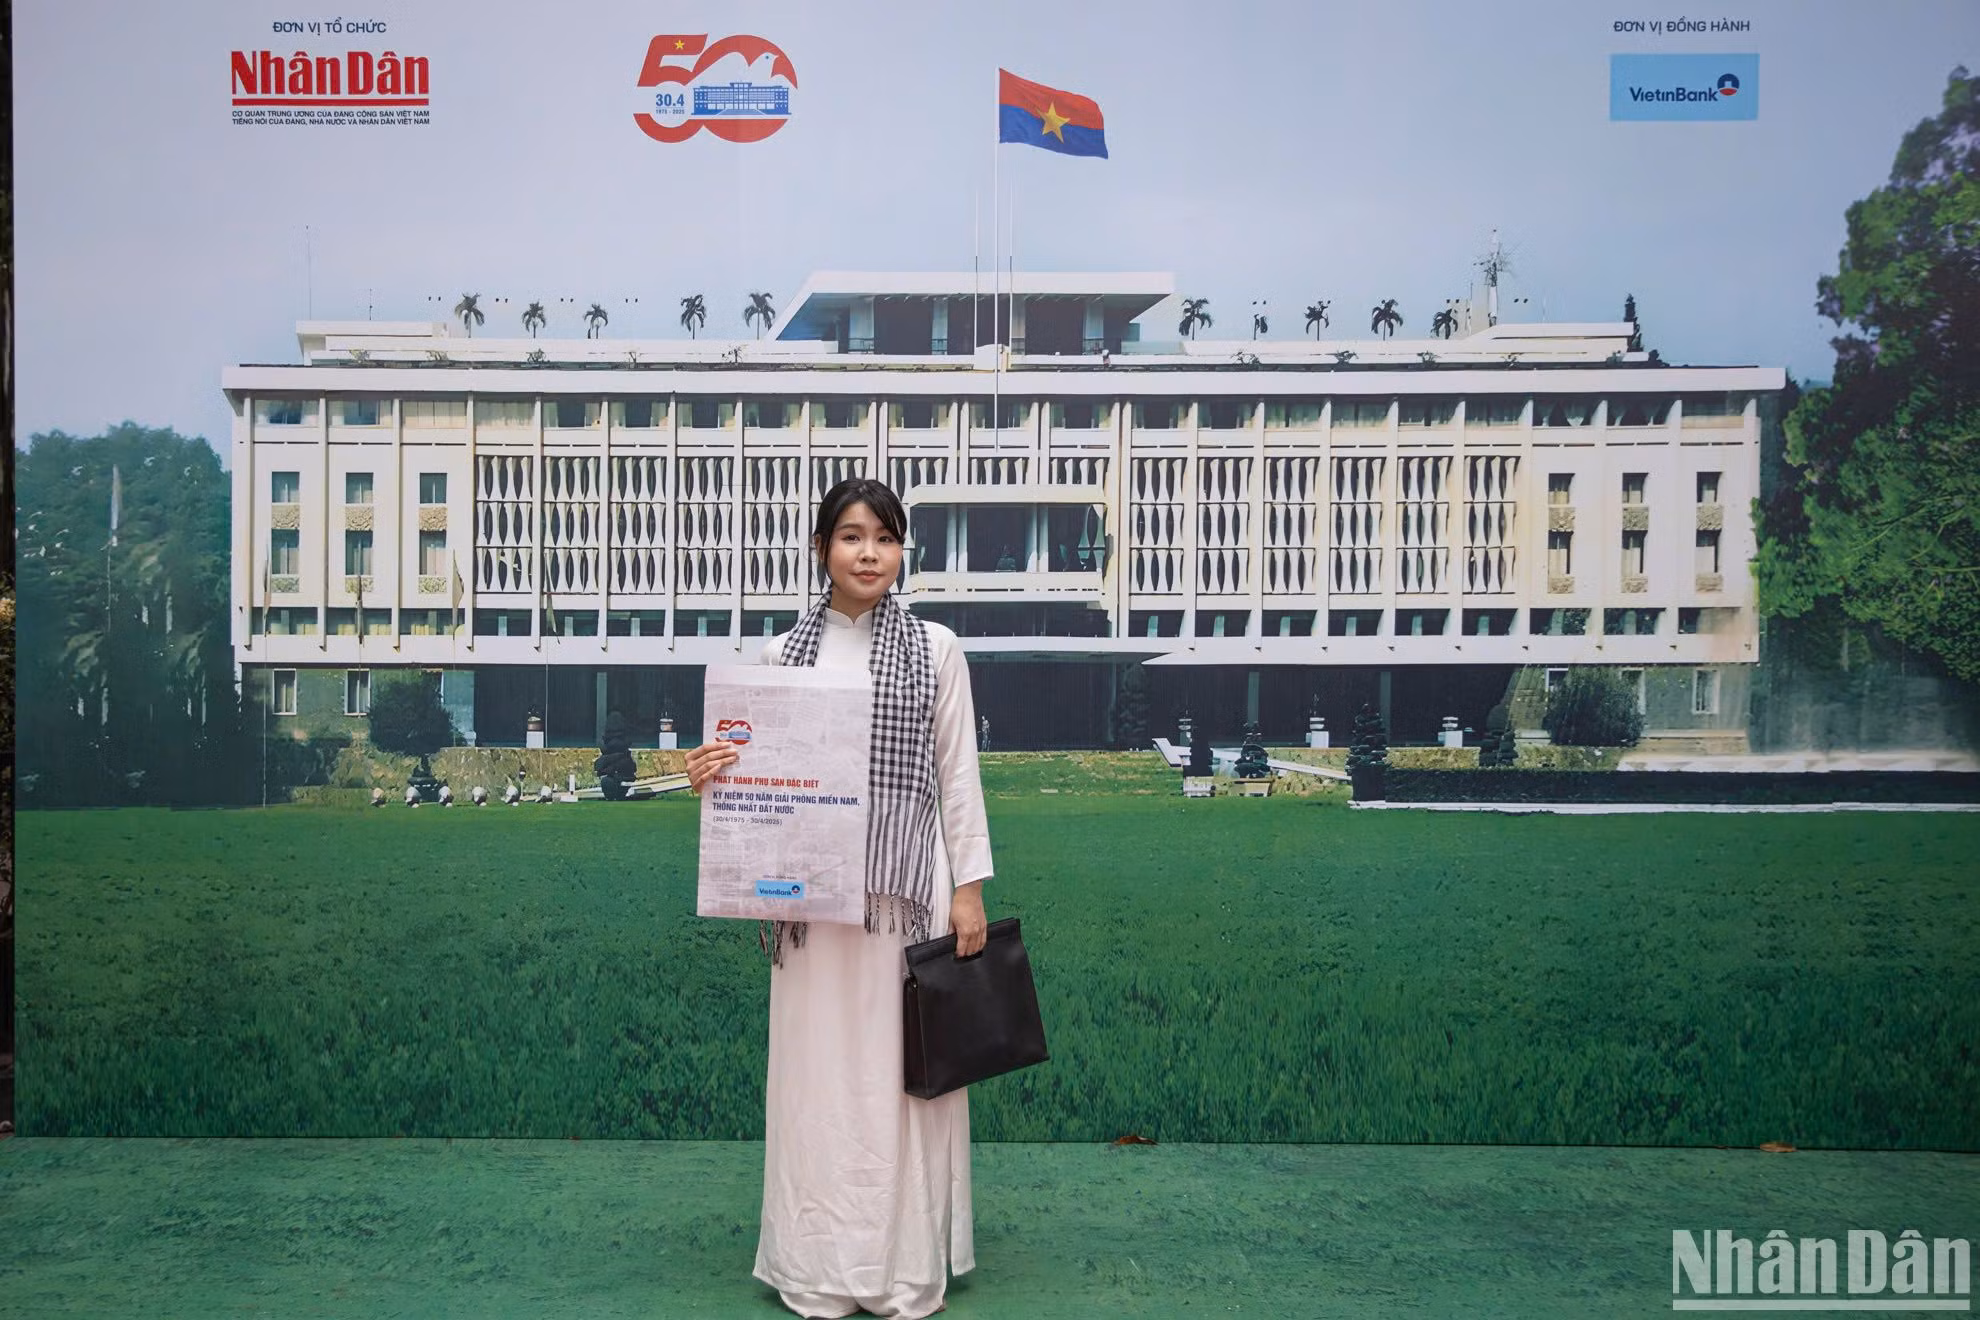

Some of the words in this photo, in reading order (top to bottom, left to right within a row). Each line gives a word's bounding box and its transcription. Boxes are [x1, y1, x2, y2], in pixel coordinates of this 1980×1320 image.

[272, 21, 304, 33] ĐƠN
[308, 22, 321, 36] VỊ
[324, 17, 342, 33] TỔ
[346, 19, 387, 33] CHỨC
[1613, 20, 1645, 32] ĐƠN
[1650, 21, 1662, 36] VỊ
[1710, 18, 1750, 32] HÀNH
[231, 50, 341, 95] Nhân
[347, 50, 430, 95] Dân
[656, 93, 685, 107] 30.4
[1629, 87, 1719, 102] VietinBank
[268, 110, 292, 118] TRUNG
[413, 110, 429, 118] NAM
[745, 793, 754, 801] 50
